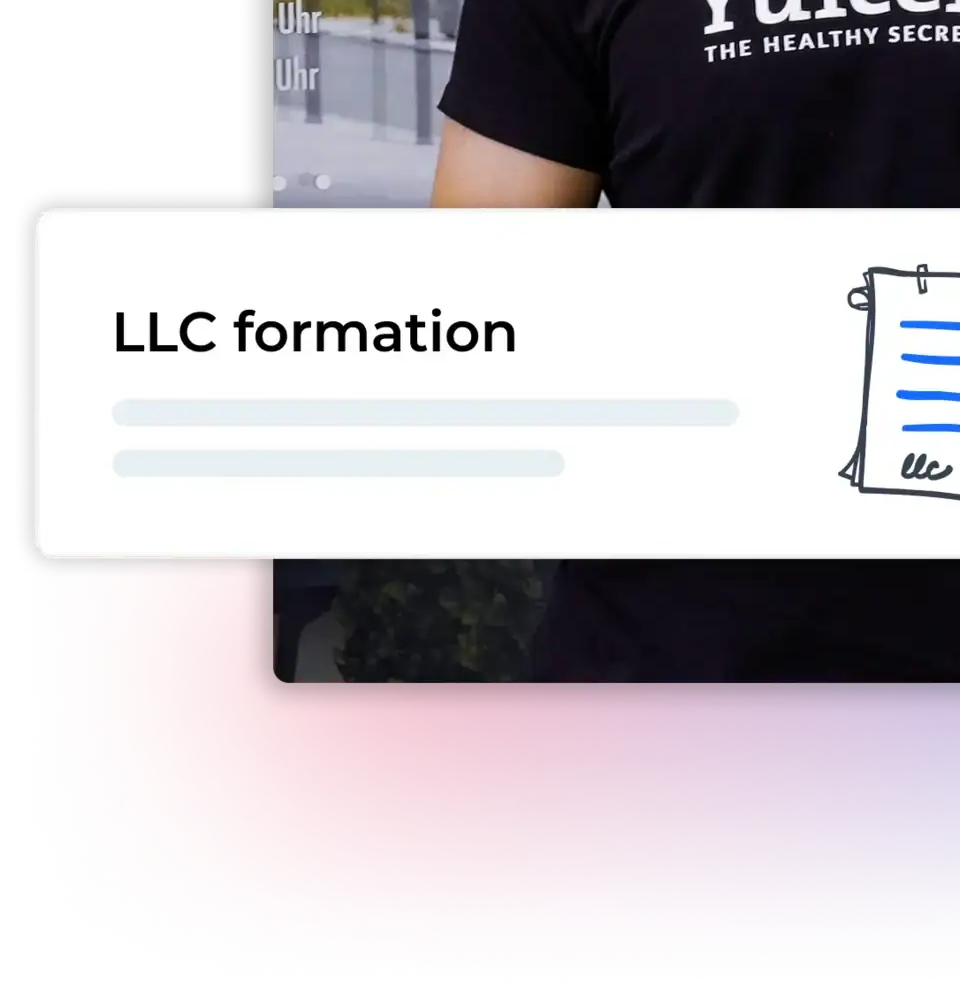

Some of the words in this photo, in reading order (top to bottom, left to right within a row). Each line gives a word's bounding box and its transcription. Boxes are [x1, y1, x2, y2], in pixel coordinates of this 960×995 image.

[278, 0, 322, 34] Uhr
[704, 39, 752, 62] THE
[763, 27, 879, 54] HEALTHY
[275, 57, 320, 91] Uhr
